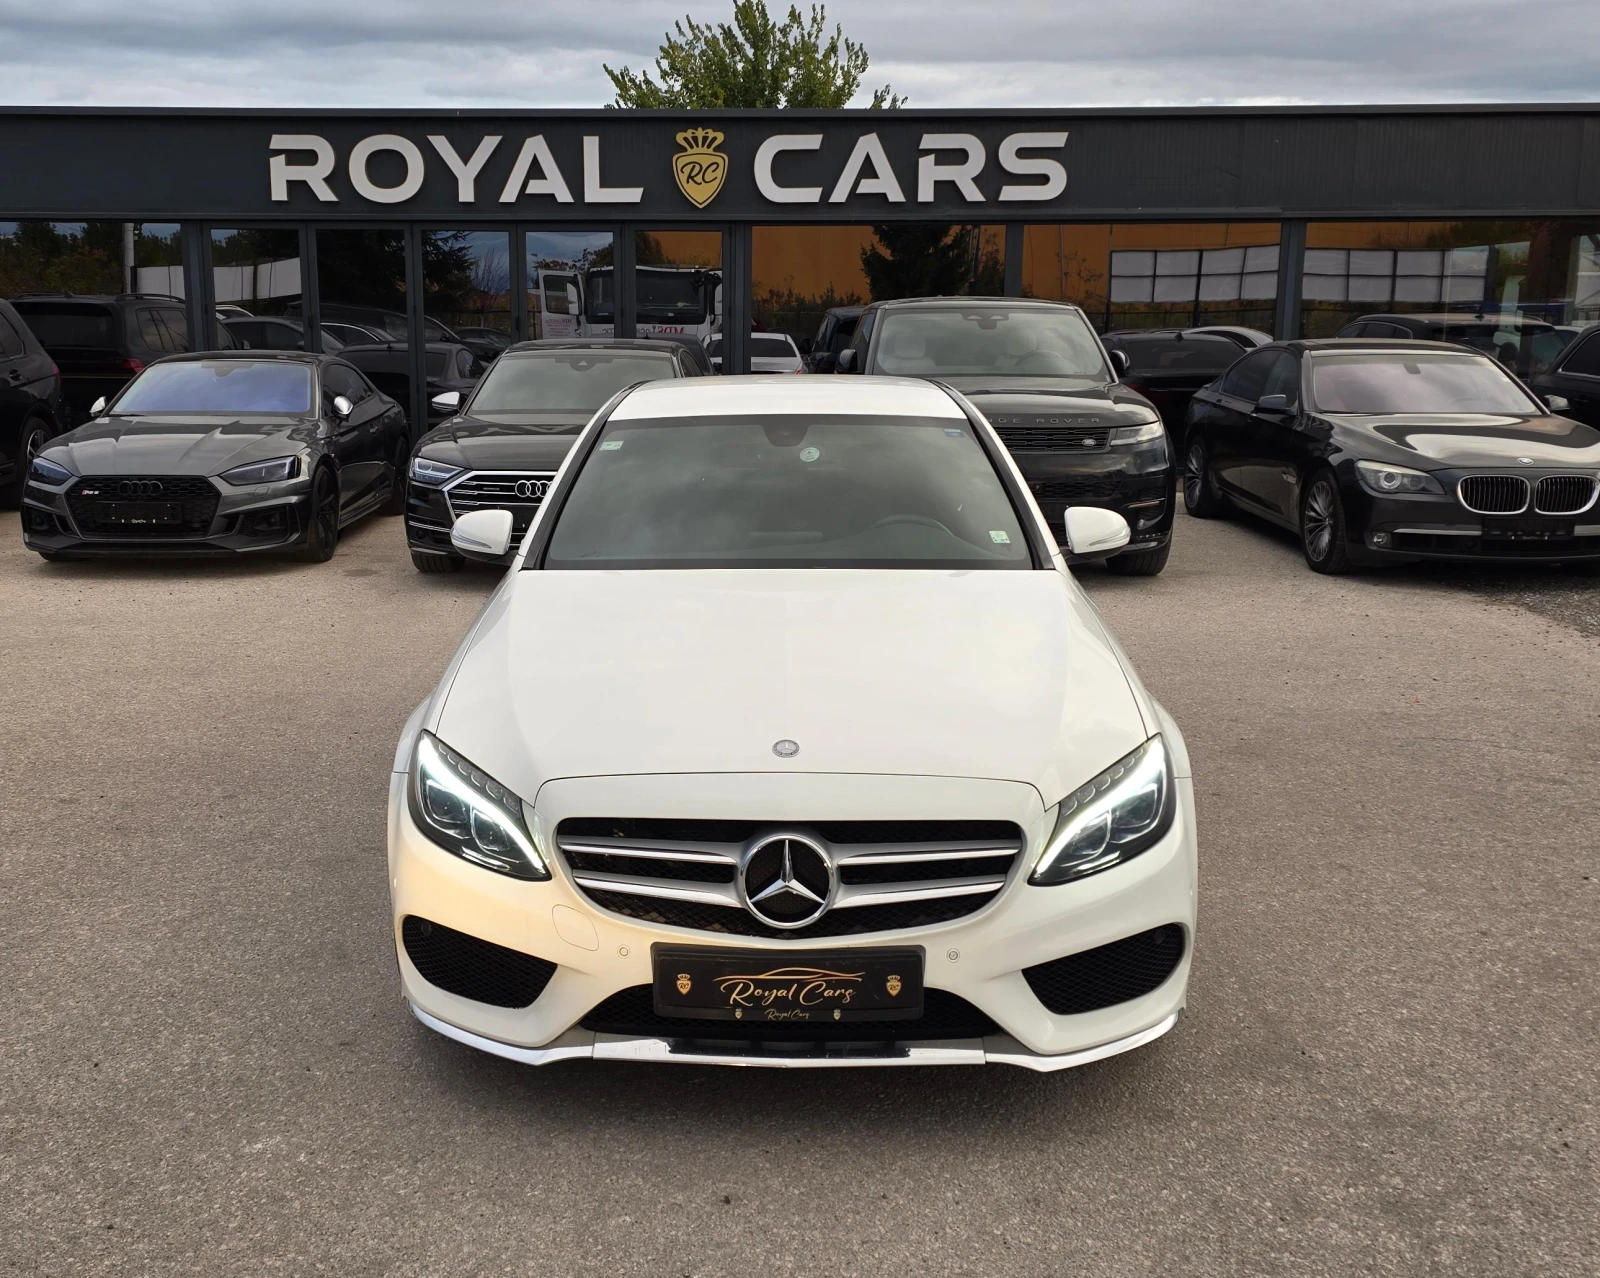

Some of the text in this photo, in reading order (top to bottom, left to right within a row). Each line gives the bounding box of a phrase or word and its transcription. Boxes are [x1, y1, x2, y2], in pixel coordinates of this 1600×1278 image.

[268, 131, 1070, 205] ROYAL RC CARS
[720, 979, 856, 1007] Royal Cars
[764, 1008, 810, 1020] Royal Cars
